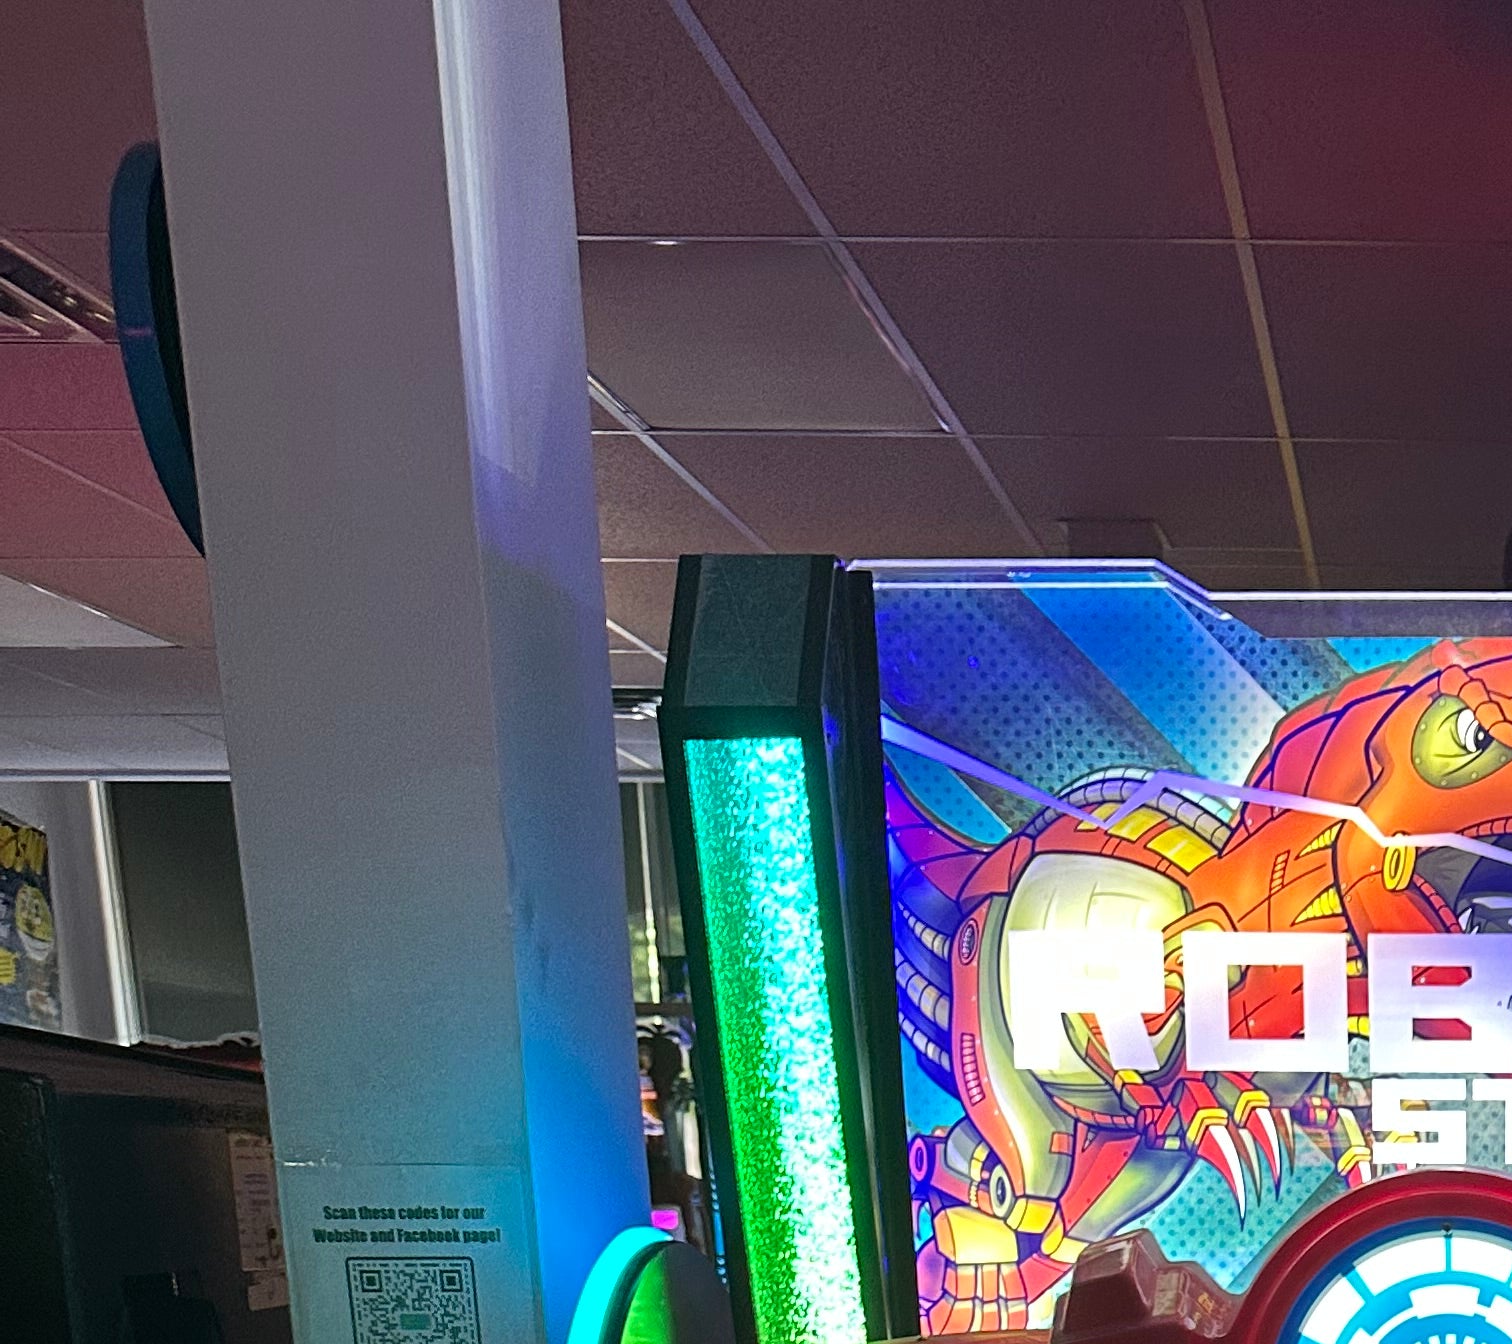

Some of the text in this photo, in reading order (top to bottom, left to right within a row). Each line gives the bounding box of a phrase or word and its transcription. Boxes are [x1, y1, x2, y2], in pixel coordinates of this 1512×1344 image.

[323, 1206, 485, 1220] Scan these codes for our
[312, 1229, 367, 1243] Website
[370, 1229, 394, 1243] and
[398, 1229, 460, 1243] Facebook
